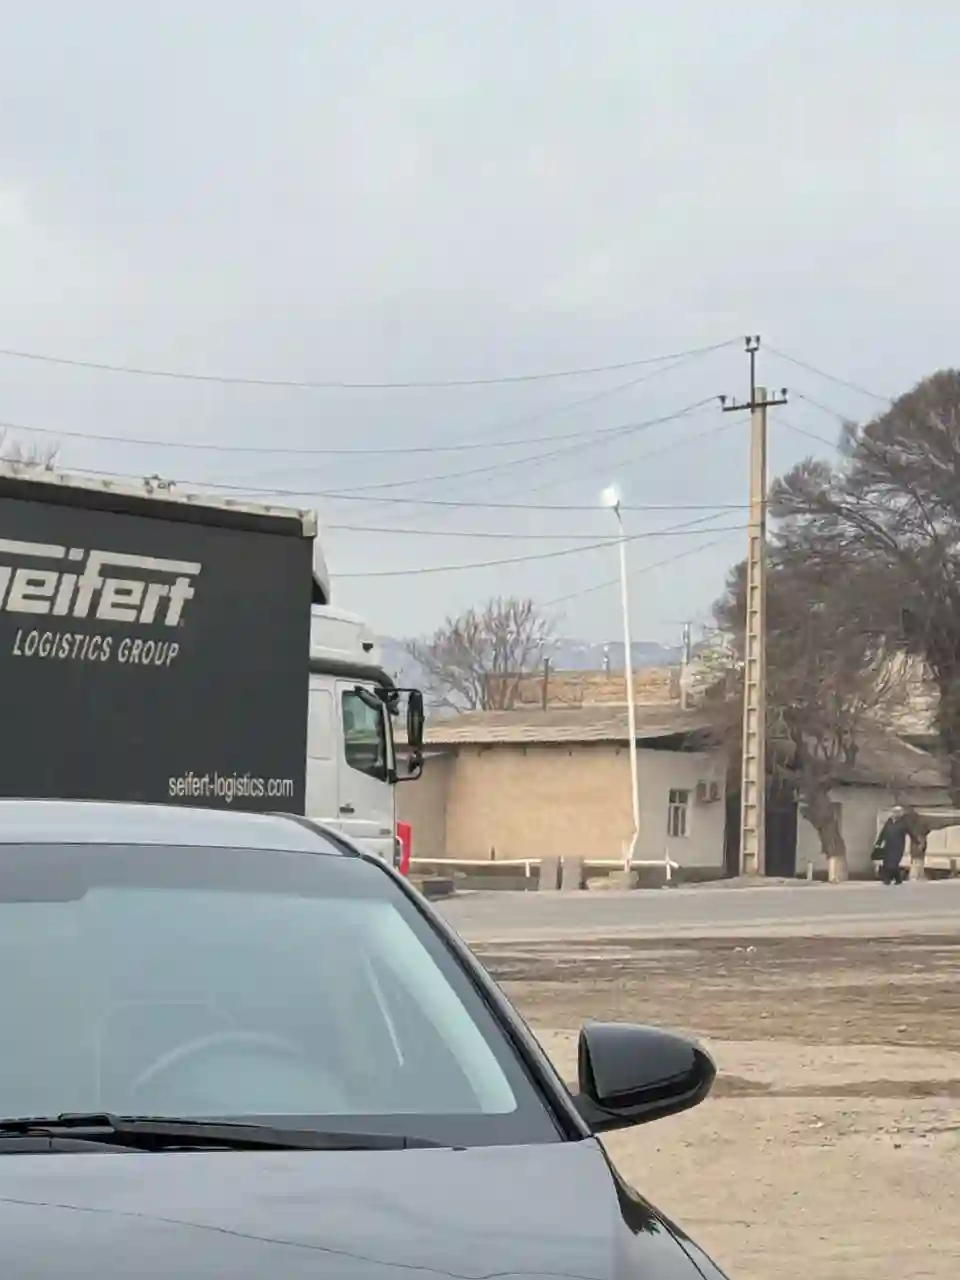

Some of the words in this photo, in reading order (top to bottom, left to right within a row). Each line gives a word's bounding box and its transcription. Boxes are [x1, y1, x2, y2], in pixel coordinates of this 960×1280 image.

[12, 629, 112, 663] LOGISTICS
[117, 638, 181, 668] GROUP
[168, 771, 294, 804] seifert-logistics.com
